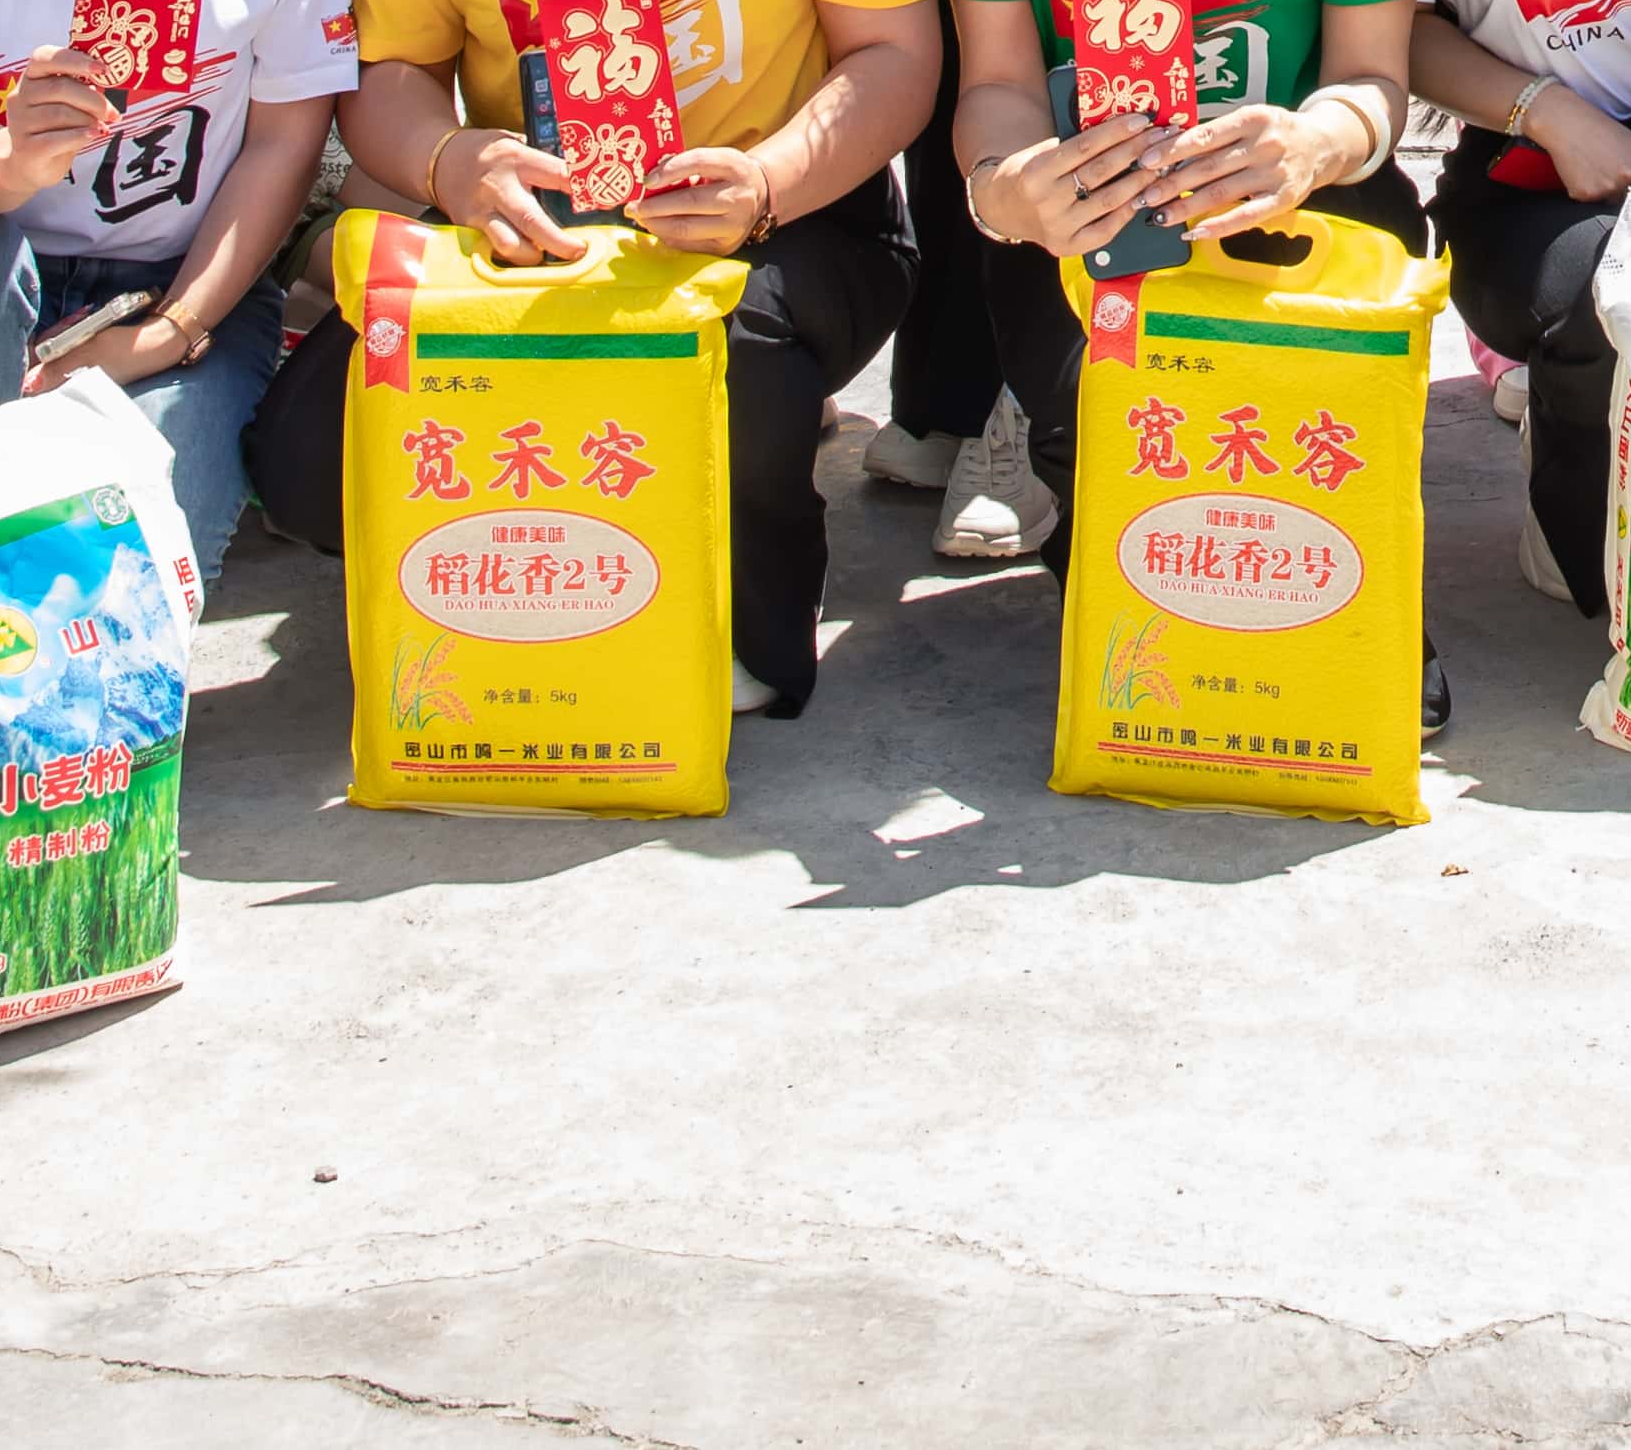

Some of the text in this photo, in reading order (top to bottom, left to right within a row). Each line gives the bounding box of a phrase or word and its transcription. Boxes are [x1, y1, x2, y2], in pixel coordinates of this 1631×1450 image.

[330, 44, 357, 56] CHINA
[1145, 353, 1216, 373] 宽禾容
[417, 373, 495, 394] 宽禾容
[1127, 396, 1366, 492] 宽禾容
[402, 418, 657, 502] 宽禾容
[1205, 507, 1277, 532] 健康美味
[491, 525, 567, 544] 健康美味
[1142, 531, 1337, 589] 稻花香2号
[424, 552, 633, 597] 稻花香2号
[1159, 579, 1320, 604] DAO HUA XIANG ER HAO
[445, 599, 615, 612] DAO HUA XIANG ER HAO
[61, 617, 102, 656] 山
[549, 688, 577, 706] 5kg
[1254, 680, 1281, 698] 5kg
[404, 741, 662, 760] 密山市鸣一米业有限公司
[1112, 722, 1359, 760] 密山市鸣一米业有限公司
[6, 820, 112, 868] 精制粉
